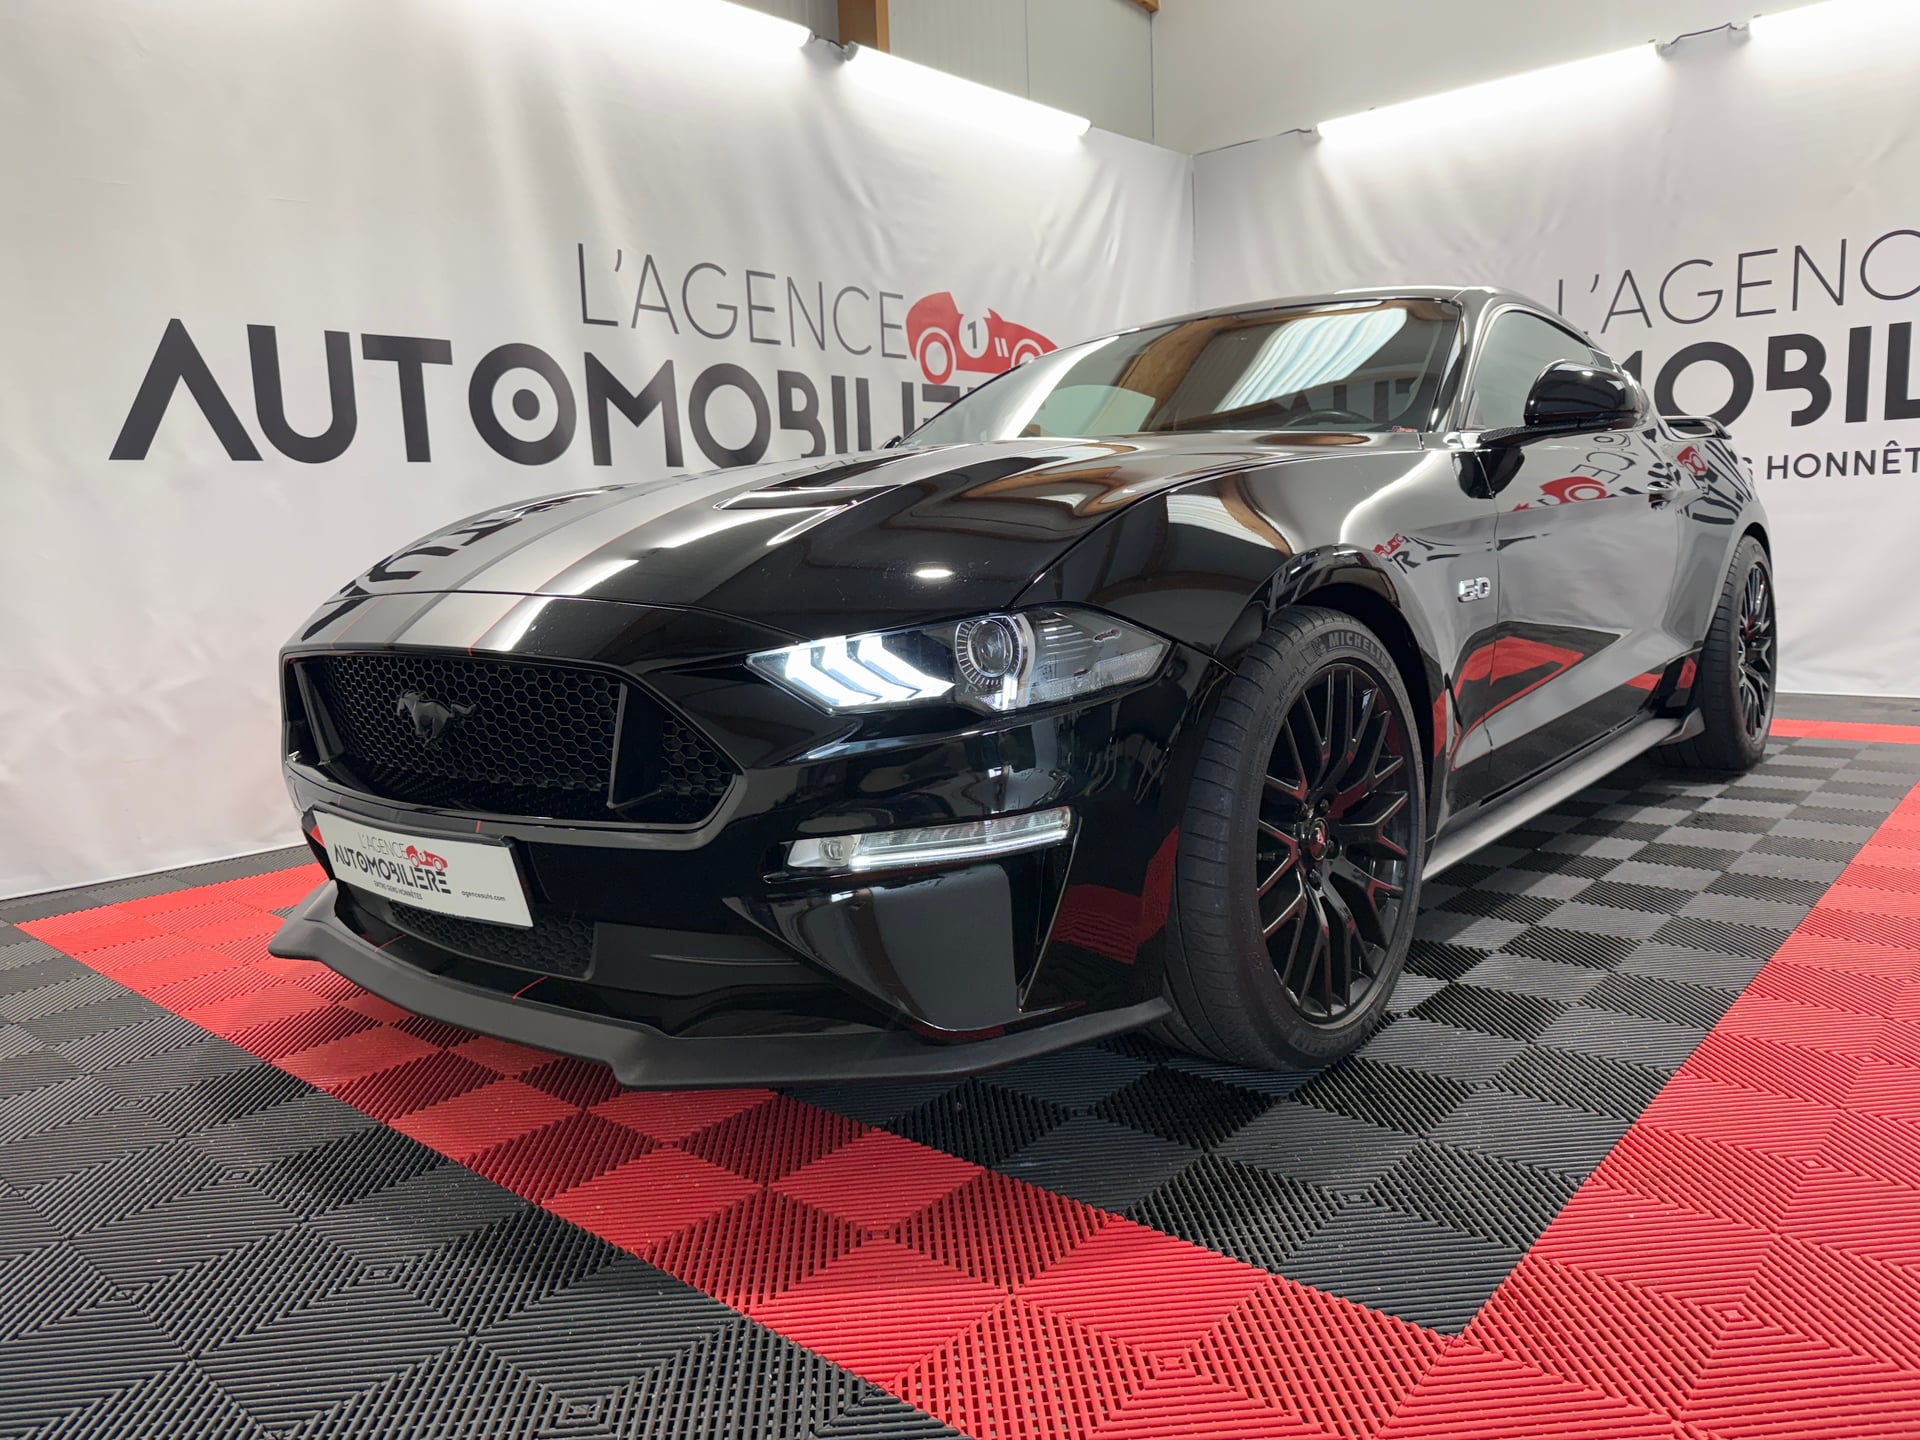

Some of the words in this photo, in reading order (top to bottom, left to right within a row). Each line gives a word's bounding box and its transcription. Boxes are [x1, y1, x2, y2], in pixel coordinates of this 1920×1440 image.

[578, 242, 907, 360] L'AGENCE
[967, 320, 978, 350] 1
[111, 318, 975, 467] AUTOMOBILI
[1620, 321, 1920, 428] OBIL
[1766, 440, 1920, 480] HONNÊT
[1328, 631, 1392, 671] MICHELIN
[358, 832, 408, 860] L'AGENCE
